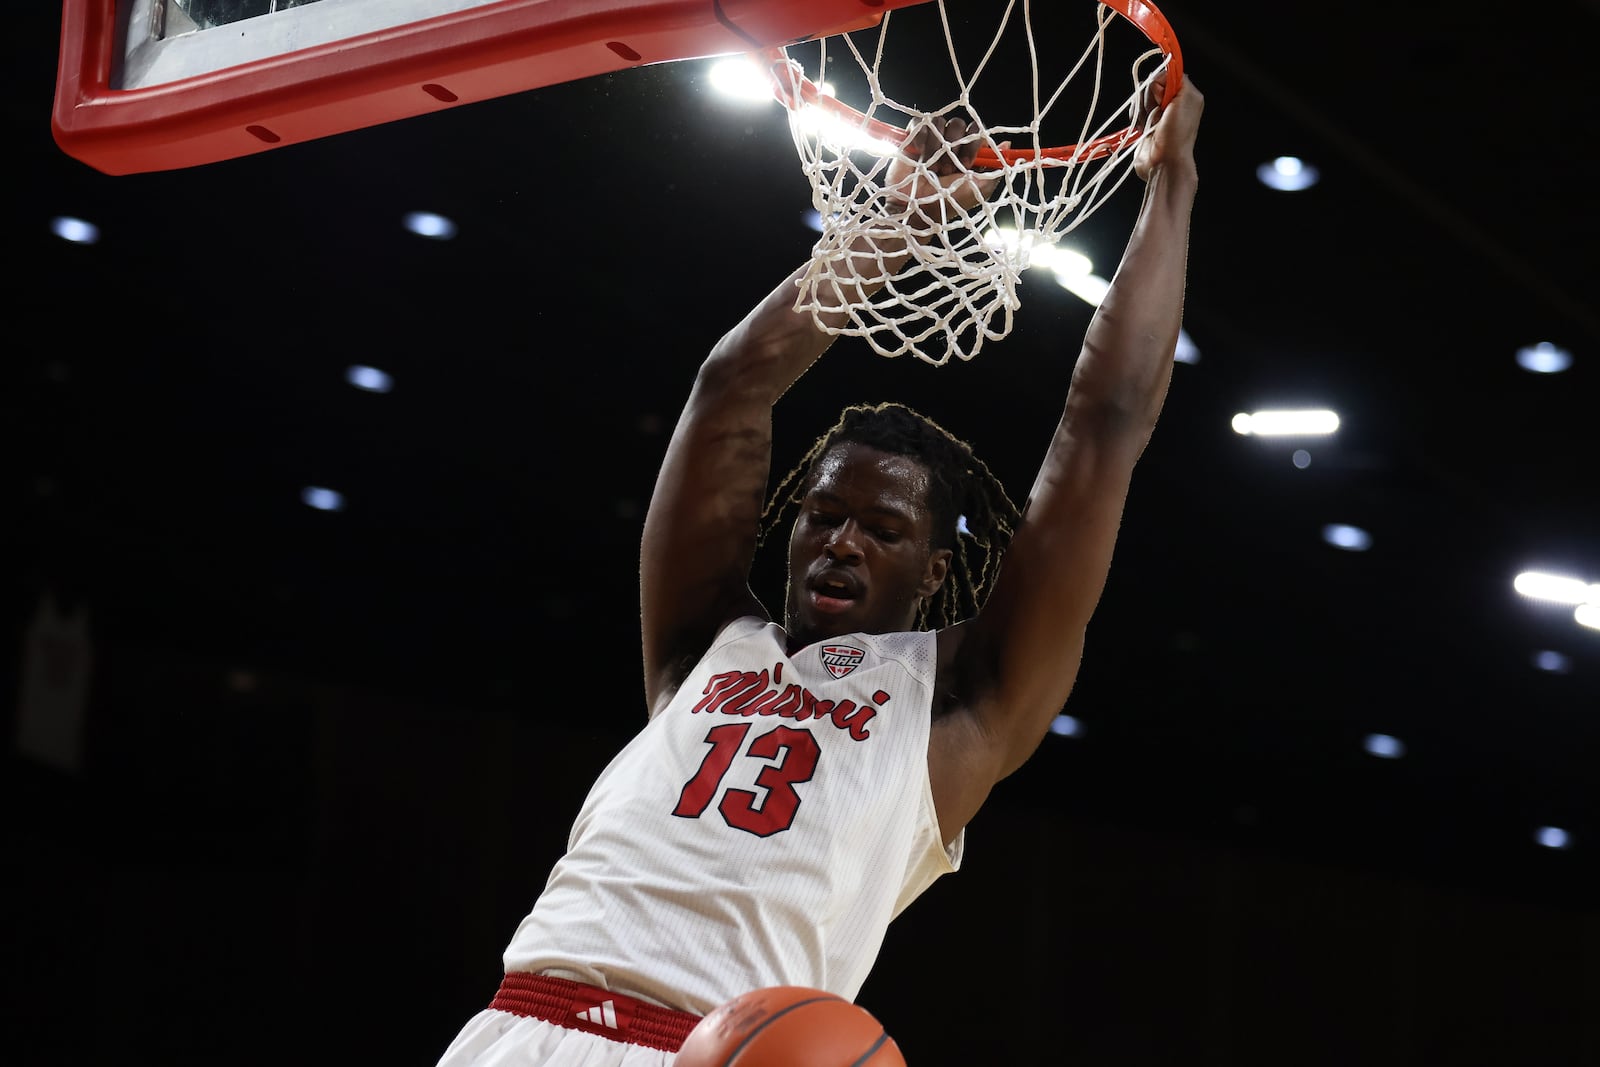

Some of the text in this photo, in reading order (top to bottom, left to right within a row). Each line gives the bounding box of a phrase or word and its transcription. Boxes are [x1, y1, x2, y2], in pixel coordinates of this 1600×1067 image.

[823, 653, 862, 666] MAC
[692, 662, 890, 741] Miami
[671, 723, 821, 838] 13
